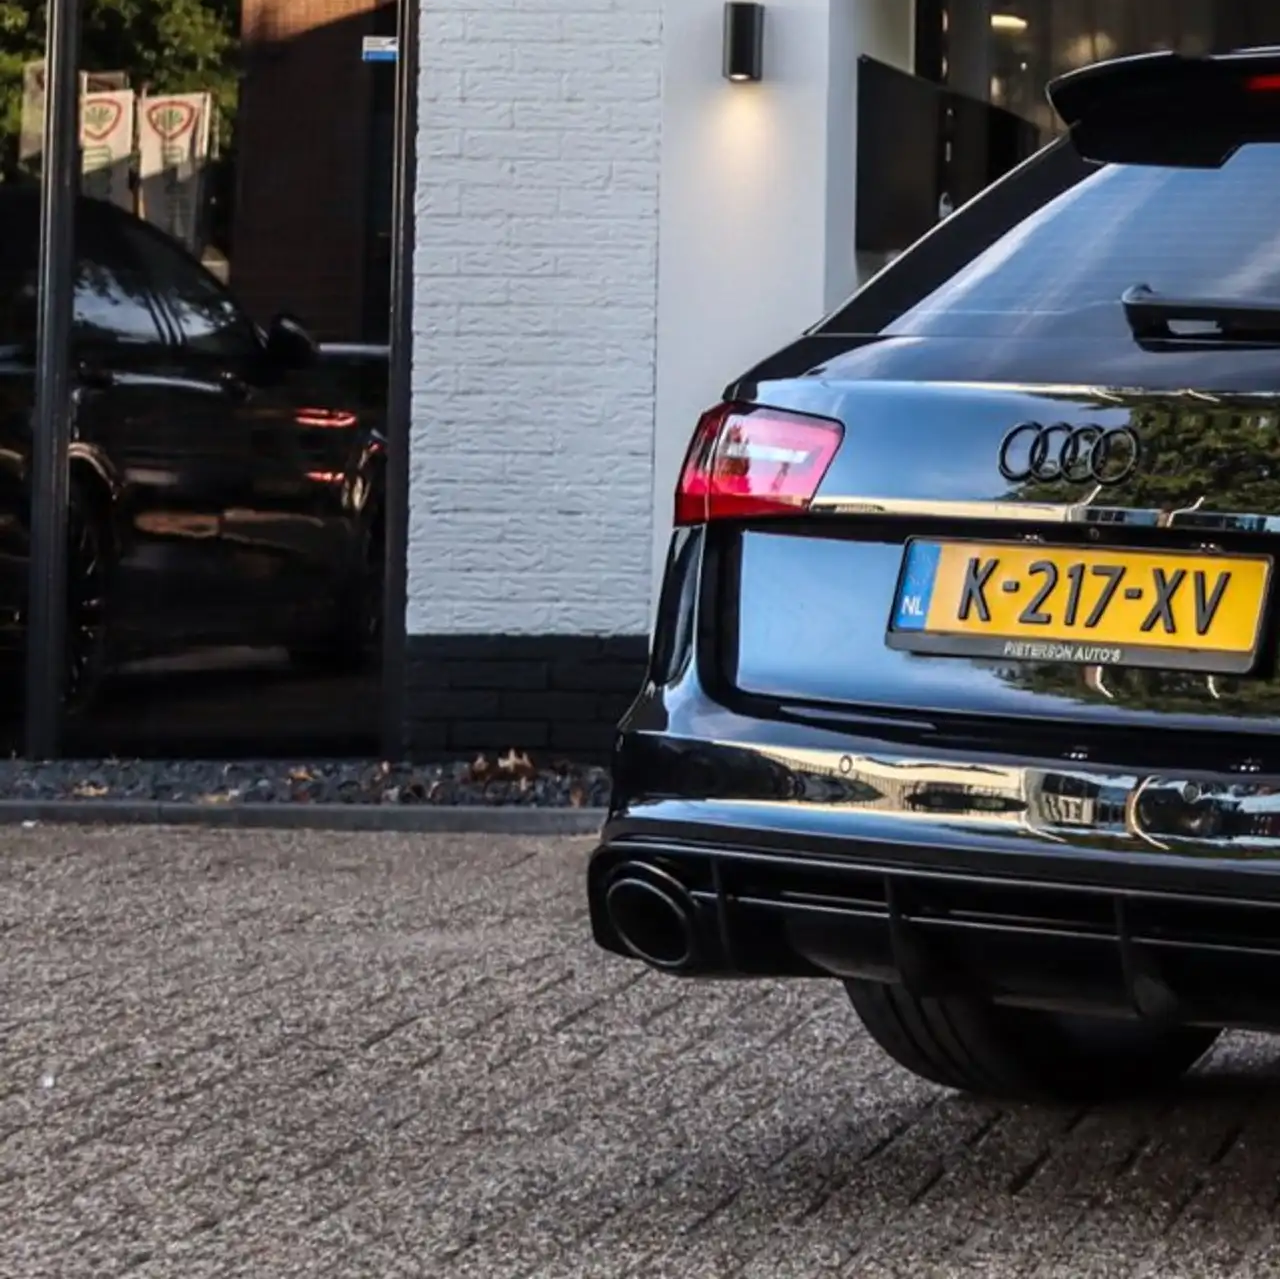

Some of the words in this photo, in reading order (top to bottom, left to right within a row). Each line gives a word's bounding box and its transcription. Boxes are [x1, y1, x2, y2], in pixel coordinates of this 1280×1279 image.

[901, 595, 924, 616] NL
[957, 557, 1231, 635] K-217-XV
[1003, 641, 1074, 659] PIETERSON
[1075, 648, 1121, 662] AUTO'S
